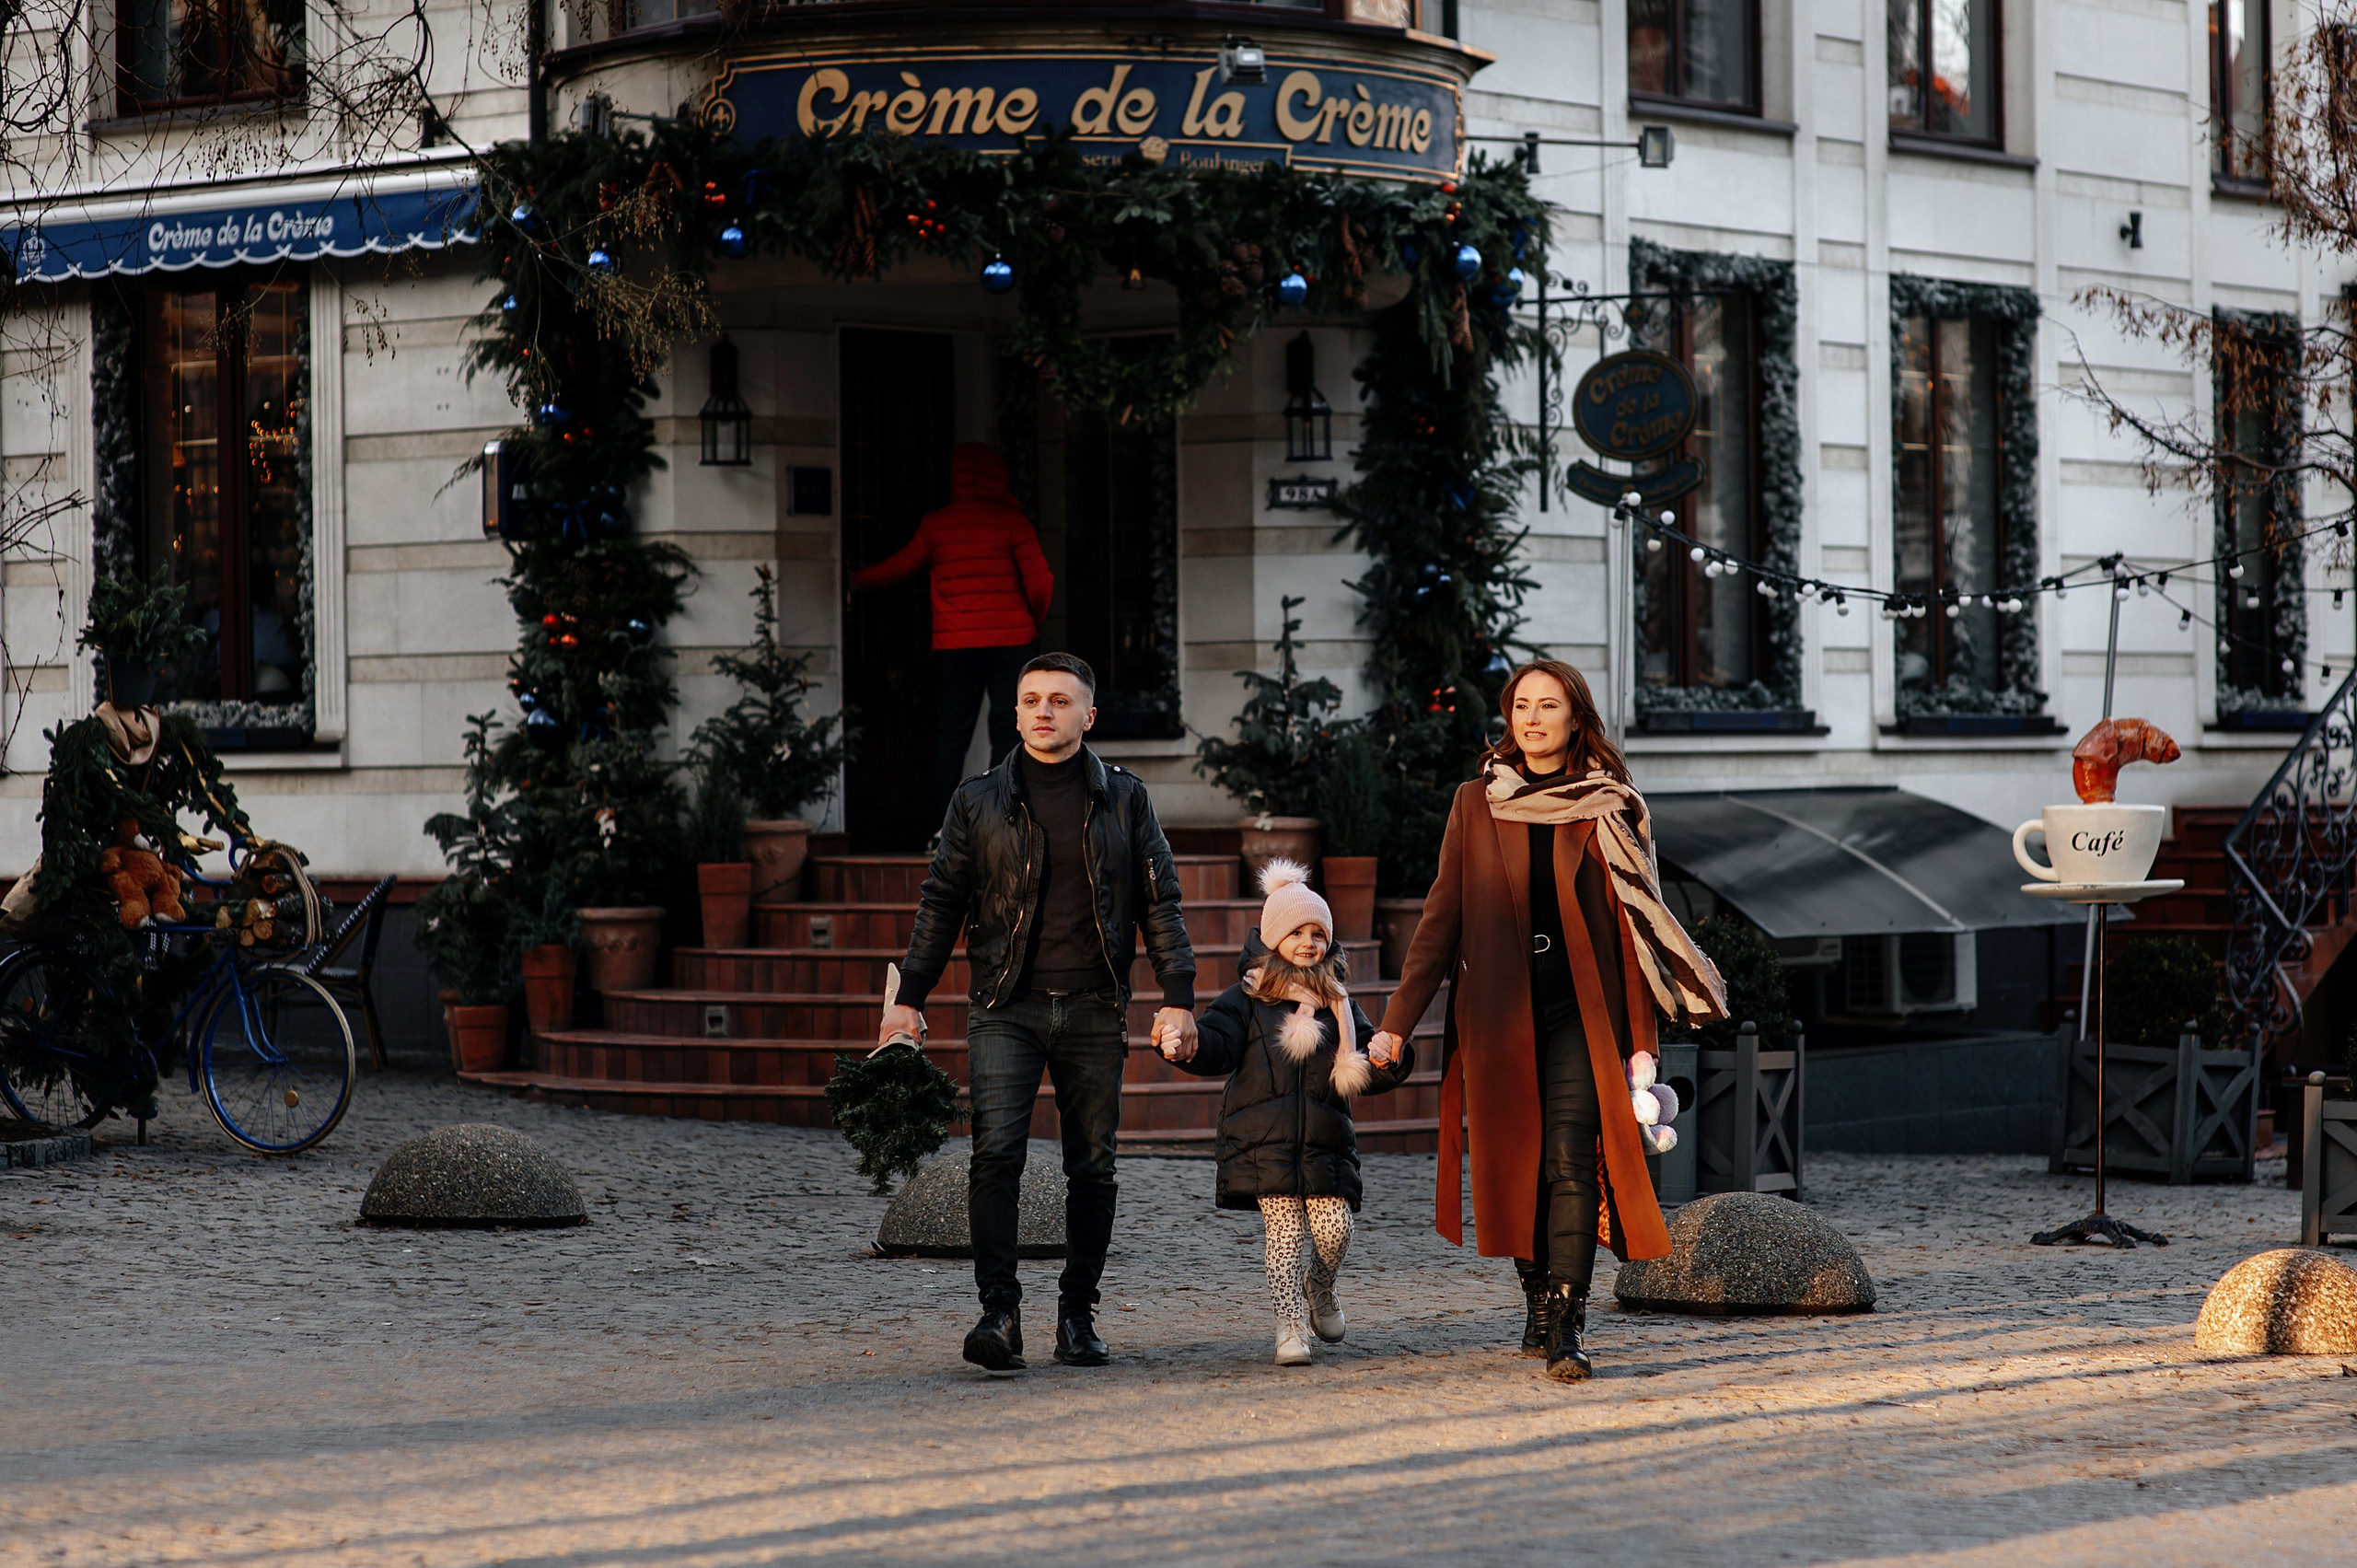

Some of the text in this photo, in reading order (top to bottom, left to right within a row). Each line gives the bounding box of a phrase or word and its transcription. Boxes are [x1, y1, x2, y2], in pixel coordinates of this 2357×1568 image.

[797, 64, 1432, 154] Crème de la Crème
[147, 210, 334, 252] Crème de la Crème
[1616, 390, 1660, 418] de la
[2072, 830, 2125, 857] Café
